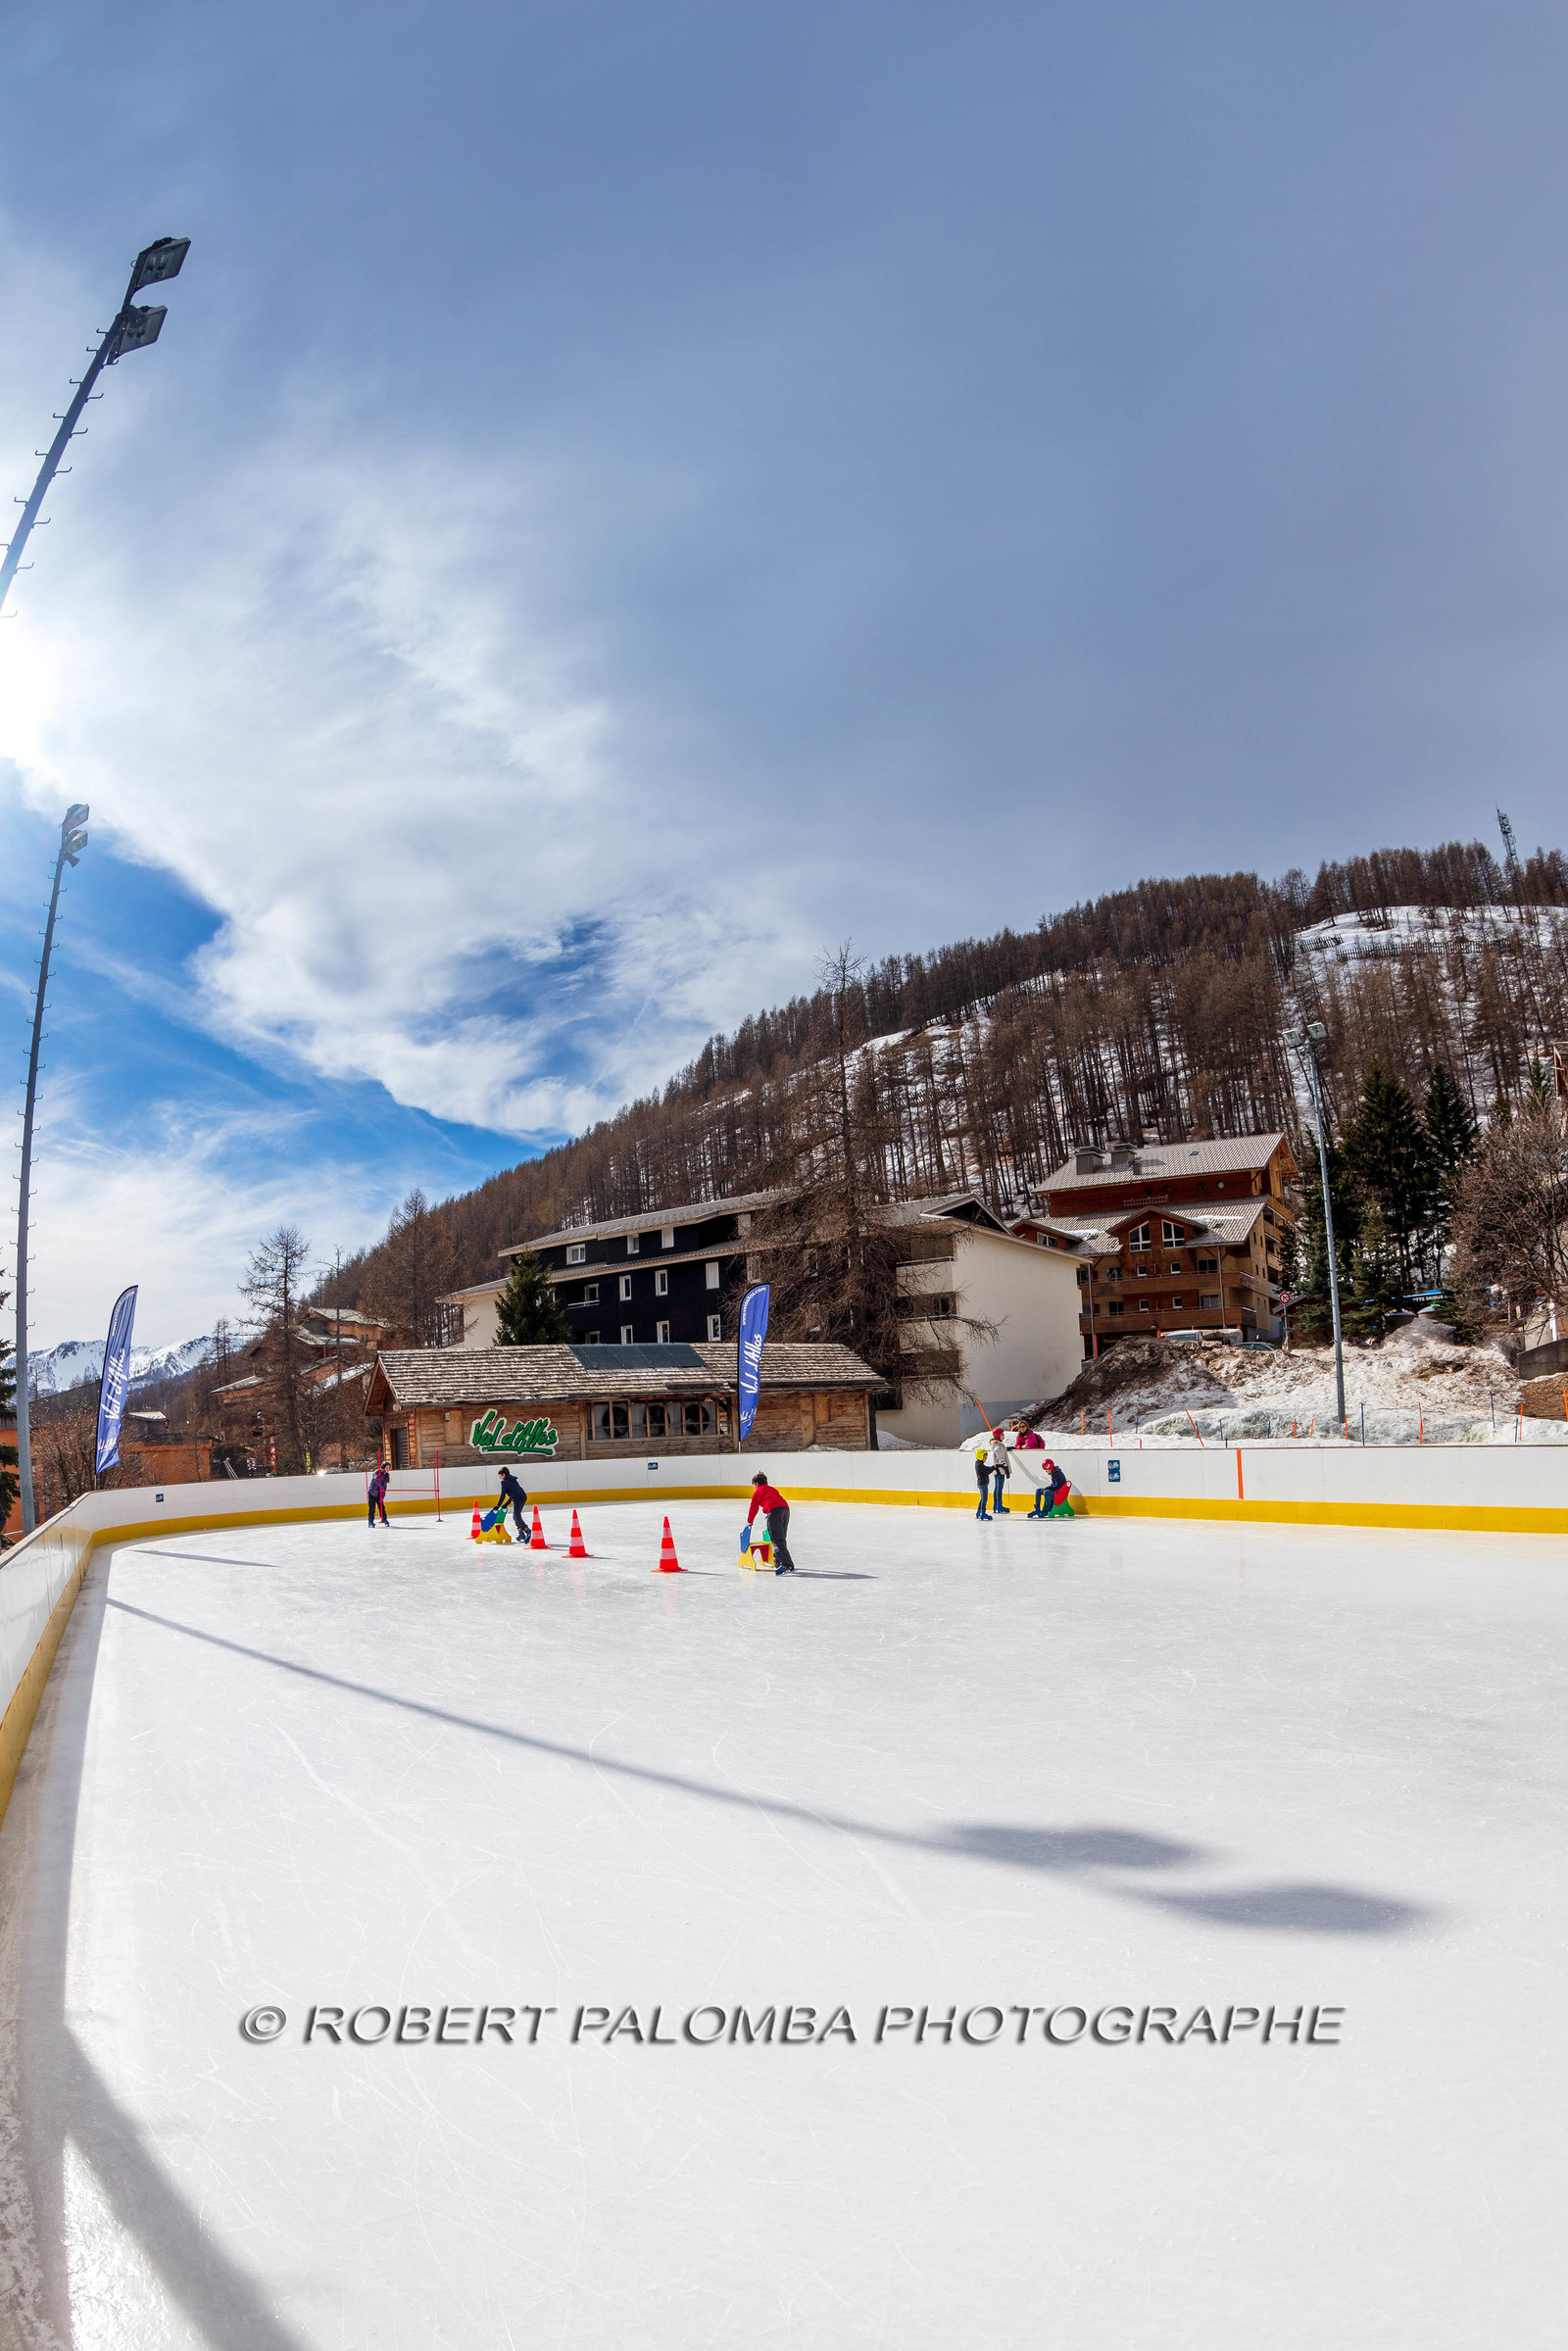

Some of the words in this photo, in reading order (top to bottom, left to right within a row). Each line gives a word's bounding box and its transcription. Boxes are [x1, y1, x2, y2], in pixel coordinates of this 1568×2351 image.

[107, 1348, 127, 1395] d'Allos
[101, 1394, 121, 1420] Val
[471, 1409, 506, 1446] Val
[501, 1417, 559, 1449] d'Allos
